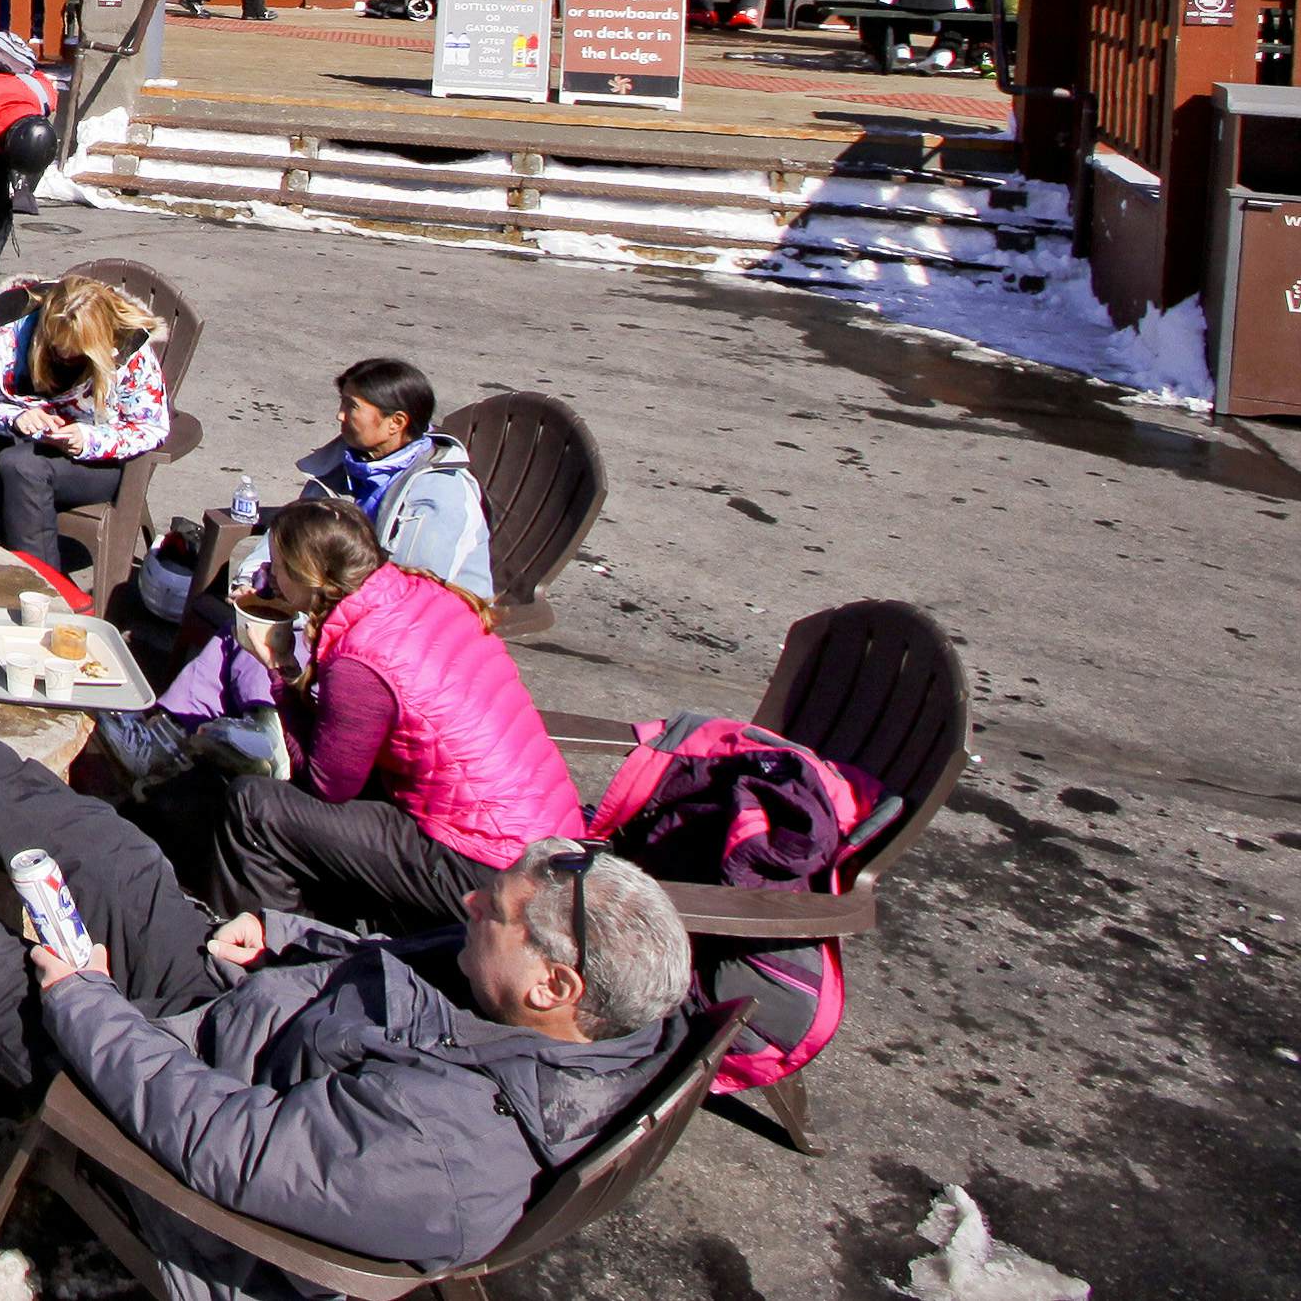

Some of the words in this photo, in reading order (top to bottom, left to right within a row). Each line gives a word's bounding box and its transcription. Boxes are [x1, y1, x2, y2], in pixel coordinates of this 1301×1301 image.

[454, 2, 499, 12] BOTTLED
[501, 3, 534, 13] WATER
[567, 8, 585, 17] or
[587, 6, 679, 20] snowboards
[485, 14, 501, 22] OR
[465, 24, 519, 34] GATORADE
[573, 28, 593, 38] on
[596, 26, 634, 39] deck
[637, 30, 655, 40] or
[657, 28, 671, 41] in
[581, 46, 607, 59] the
[610, 47, 662, 65] Lodge.
